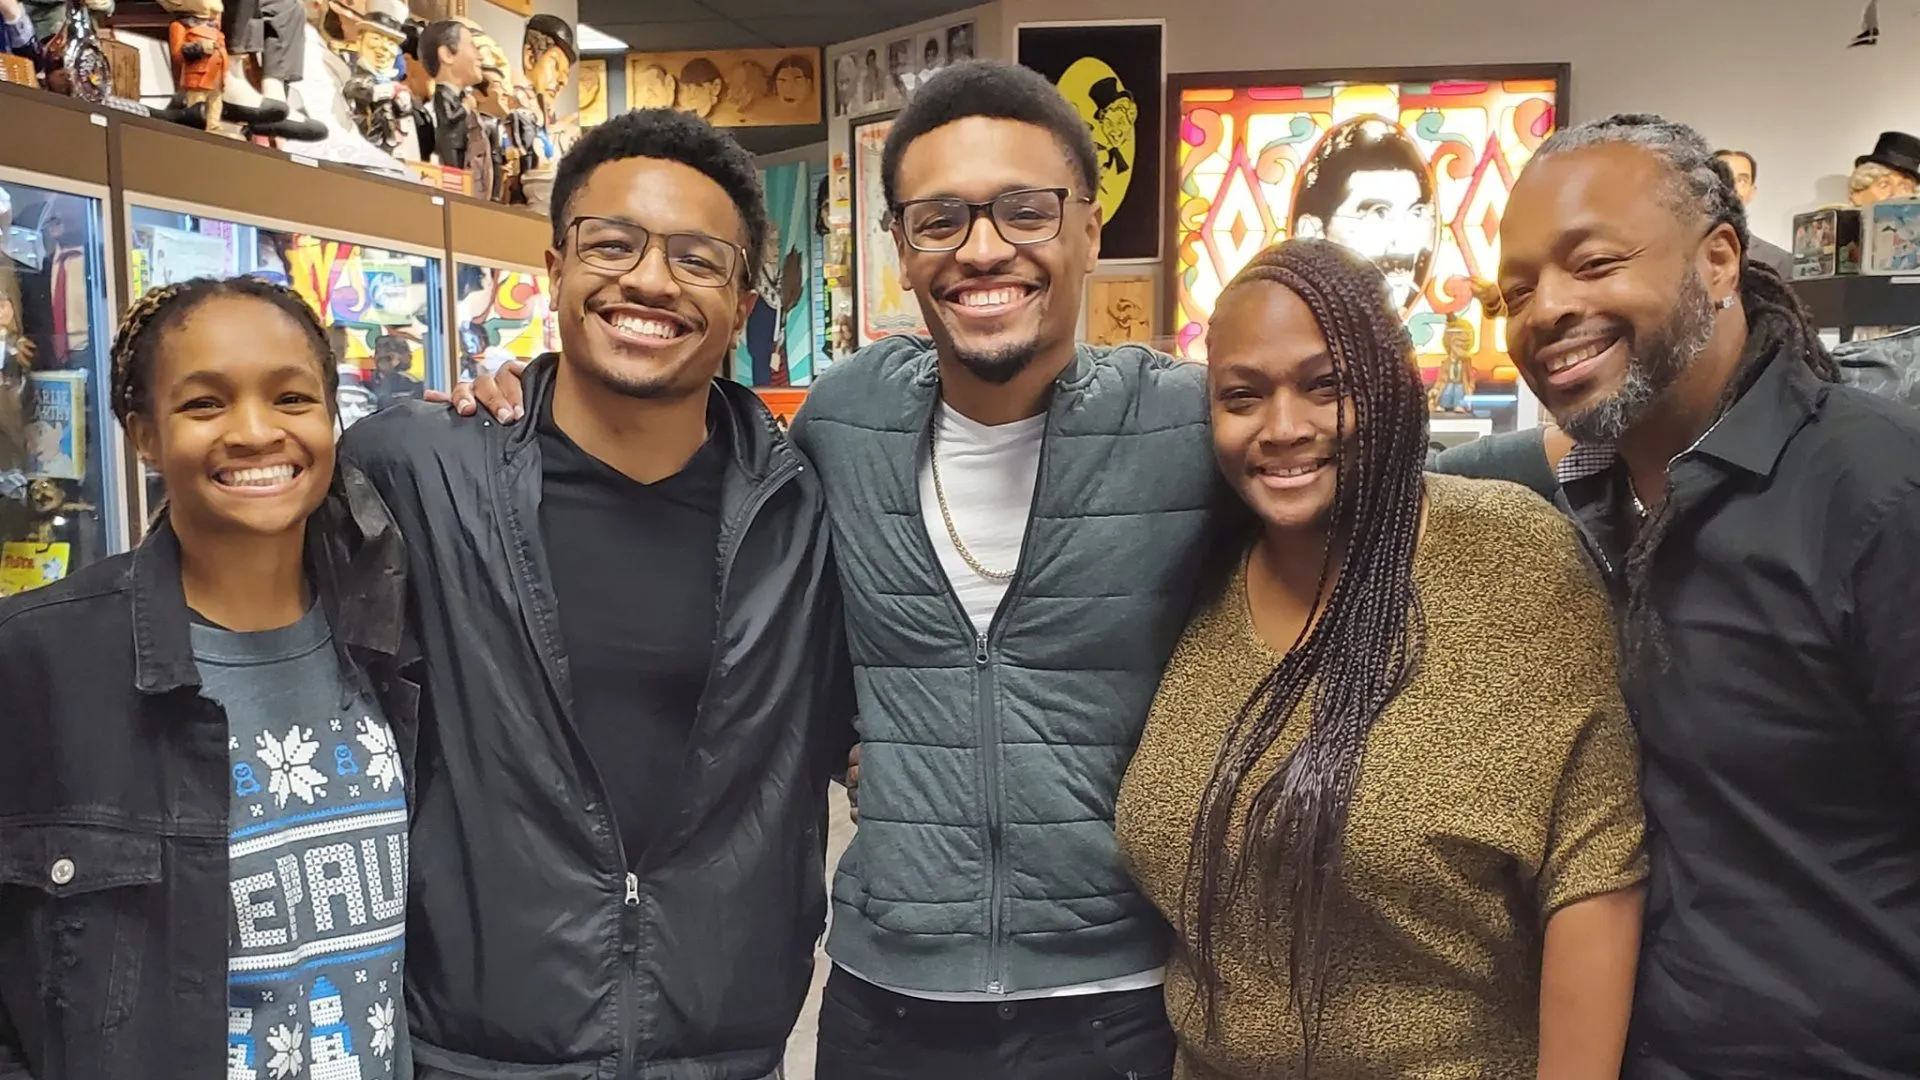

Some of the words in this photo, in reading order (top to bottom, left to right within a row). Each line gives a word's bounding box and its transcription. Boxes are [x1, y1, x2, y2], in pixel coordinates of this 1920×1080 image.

[32, 389, 69, 405] ARLIE
[34, 405, 70, 420] ARTHY
[229, 832, 408, 949] EPAU
